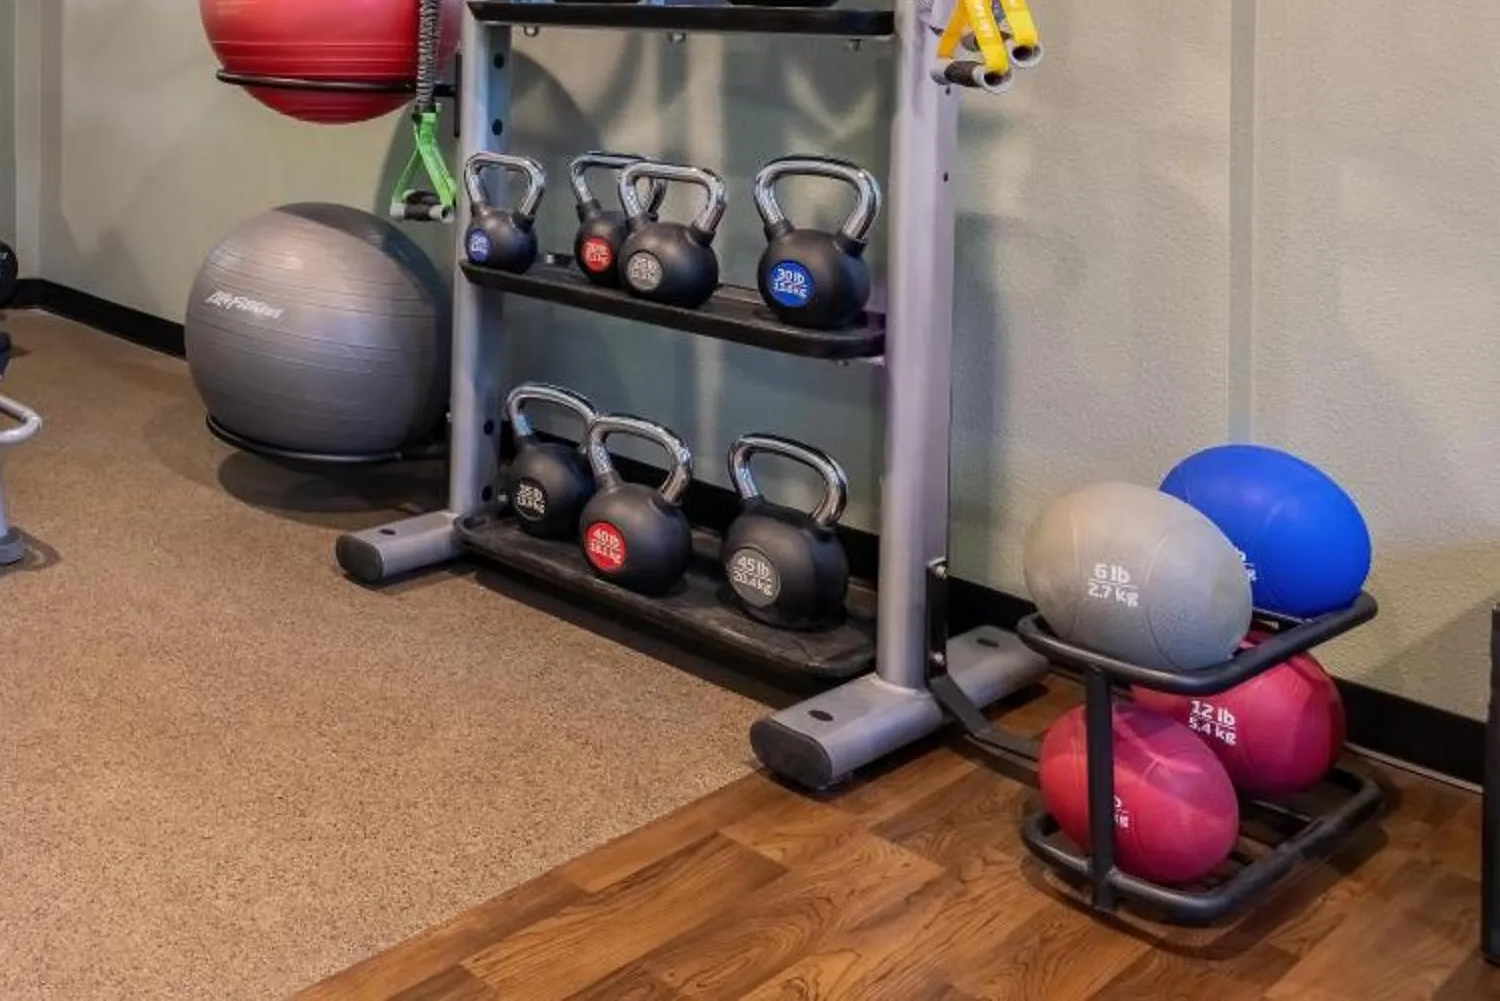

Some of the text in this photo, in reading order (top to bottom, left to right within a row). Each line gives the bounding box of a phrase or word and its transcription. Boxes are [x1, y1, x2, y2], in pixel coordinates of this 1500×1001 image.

[778, 268, 793, 280] 30
[737, 557, 755, 571] 45
[1095, 563, 1131, 583] 6 lb
[1088, 582, 1112, 599] 2.7
[1191, 700, 1236, 725] 12 lb
